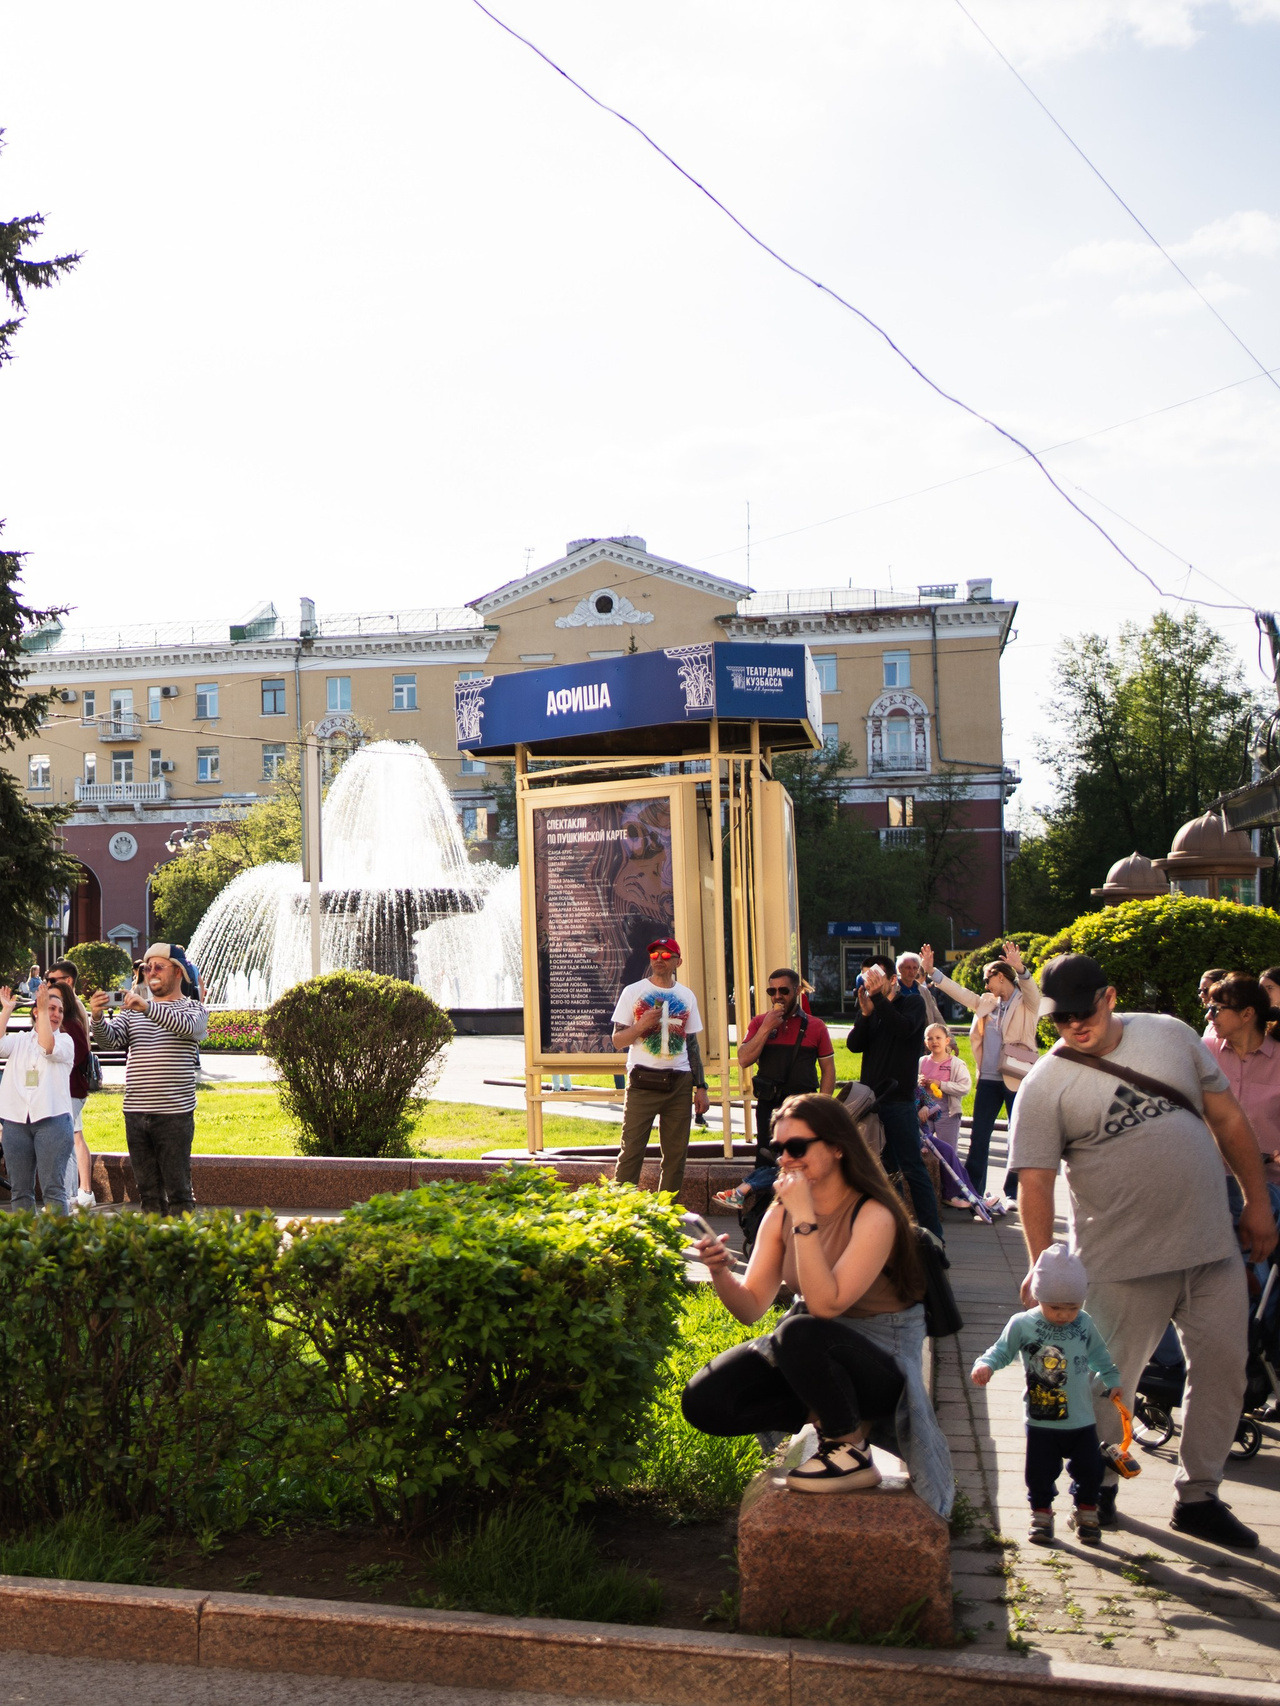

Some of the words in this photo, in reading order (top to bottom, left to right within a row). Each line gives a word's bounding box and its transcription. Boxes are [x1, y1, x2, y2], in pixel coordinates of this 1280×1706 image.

[746, 666, 767, 676] ТЕАТР
[767, 667, 793, 677] ДРАМЫ
[746, 677, 783, 687] КУЗБАССА
[546, 682, 611, 716] АФИША
[547, 818, 587, 830] СПЕКТАКЛИ
[547, 834, 556, 844] ПО
[557, 829, 605, 843] ПУШКИНСКОЙ
[606, 829, 627, 840] КАРТЕ
[1104, 1098, 1183, 1135] adida
